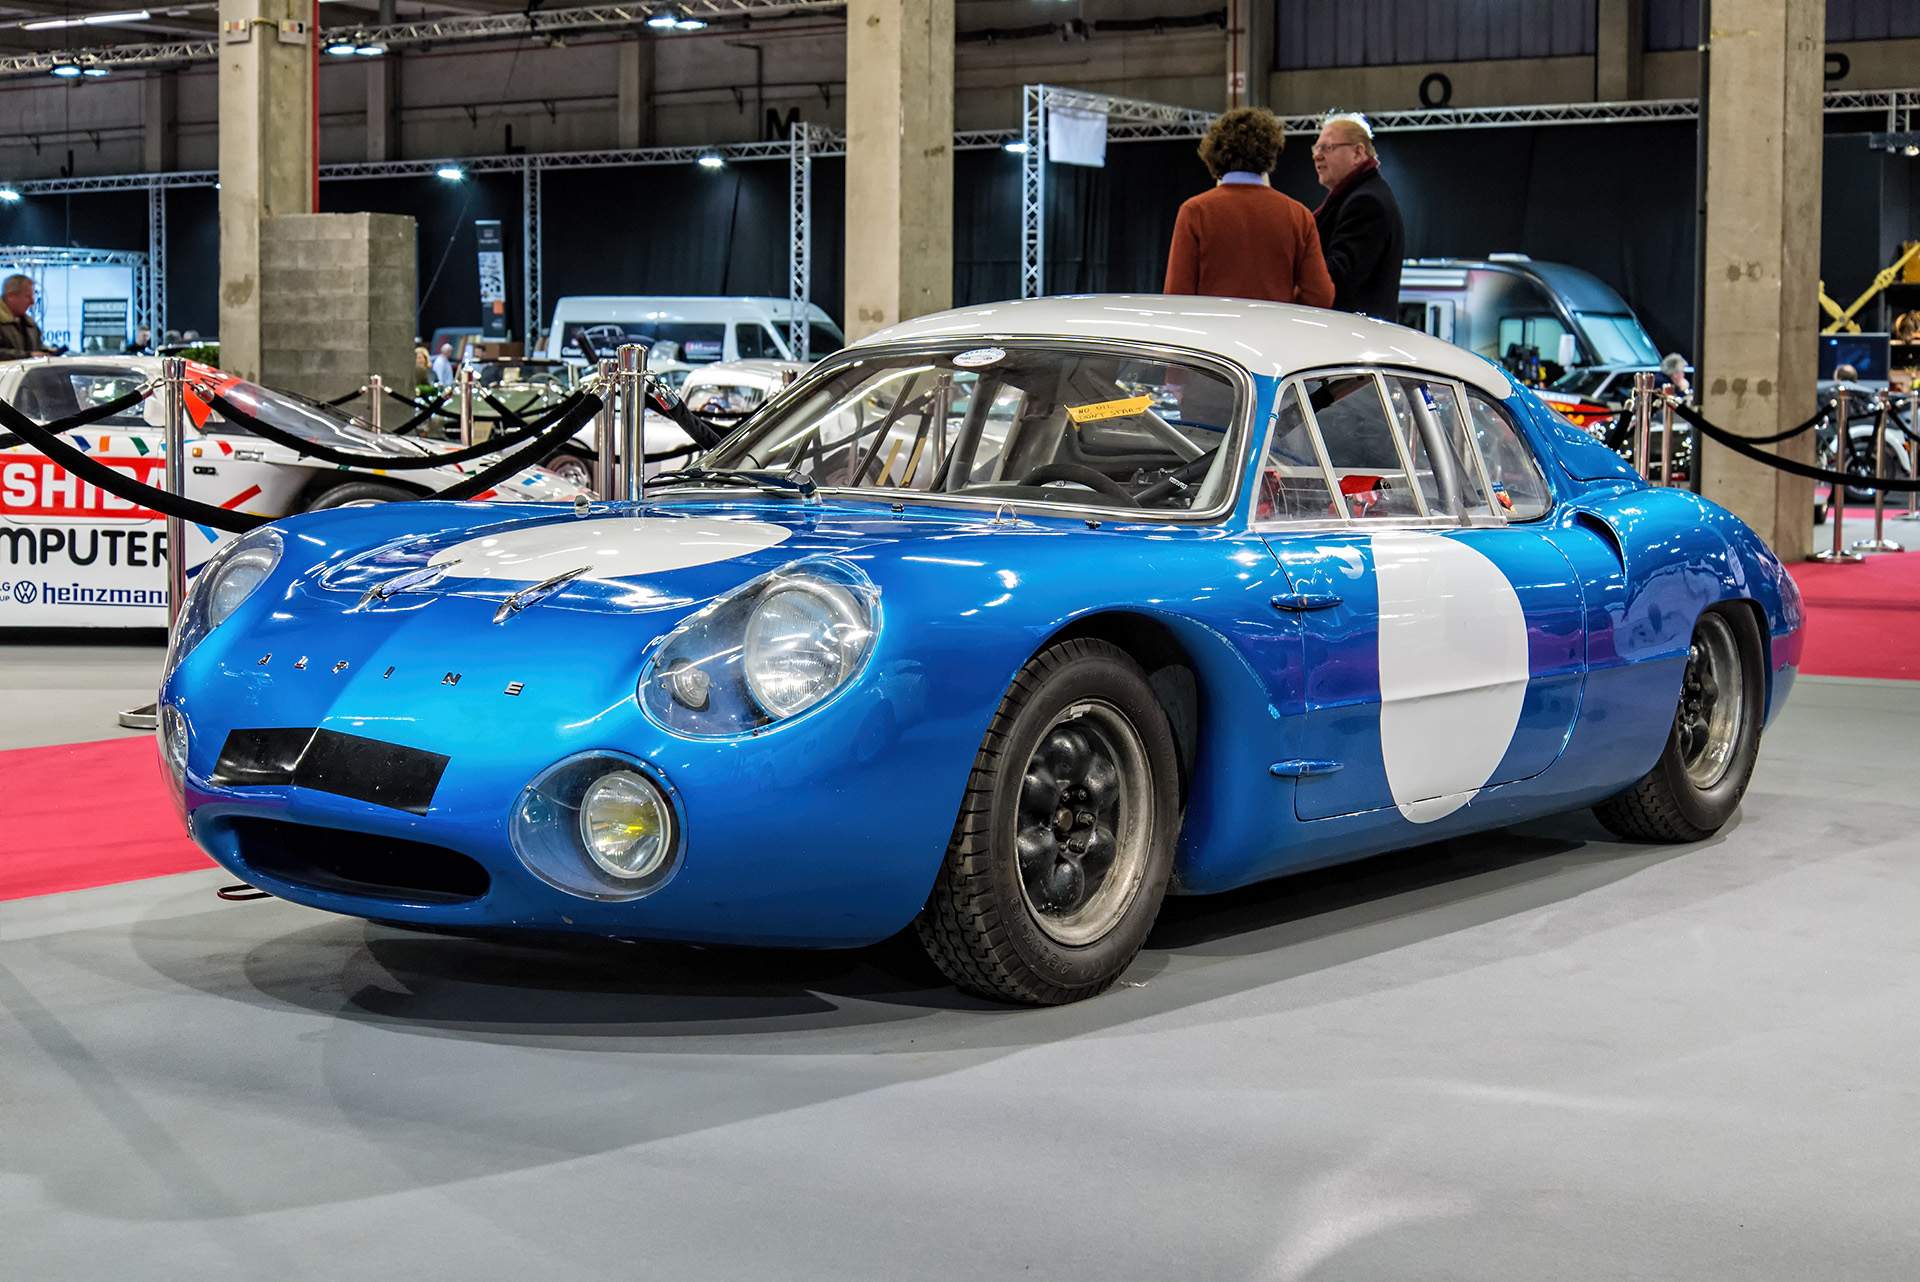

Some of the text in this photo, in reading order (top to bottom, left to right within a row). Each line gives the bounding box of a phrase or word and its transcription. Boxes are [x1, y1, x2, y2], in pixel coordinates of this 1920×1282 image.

[1419, 72, 1452, 108] O
[766, 108, 799, 141] M
[43, 582, 168, 605] heinzman
[257, 652, 526, 697] ALPINE
